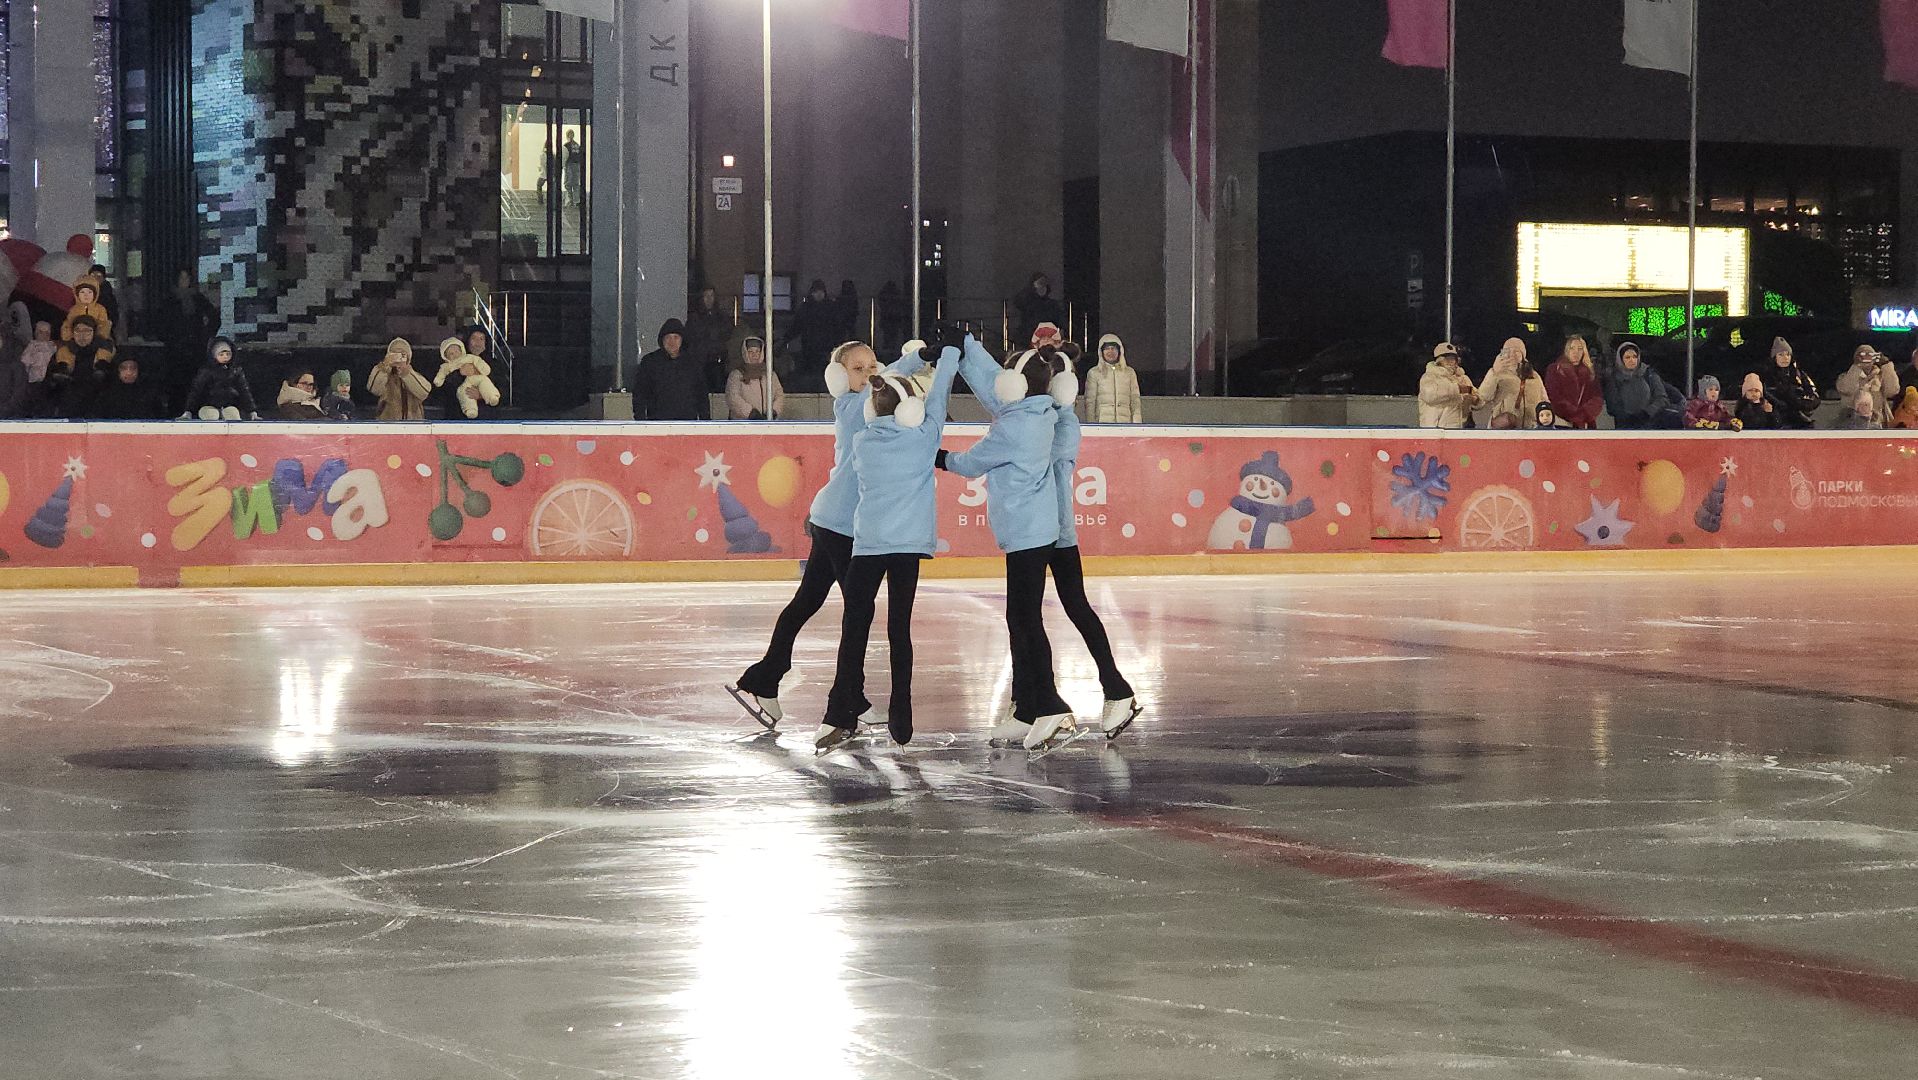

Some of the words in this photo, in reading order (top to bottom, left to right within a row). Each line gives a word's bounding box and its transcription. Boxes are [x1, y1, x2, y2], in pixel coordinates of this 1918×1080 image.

[165, 457, 389, 551] Зима
[957, 466, 1107, 507] за
[1818, 480, 1863, 493] ПАРКИ
